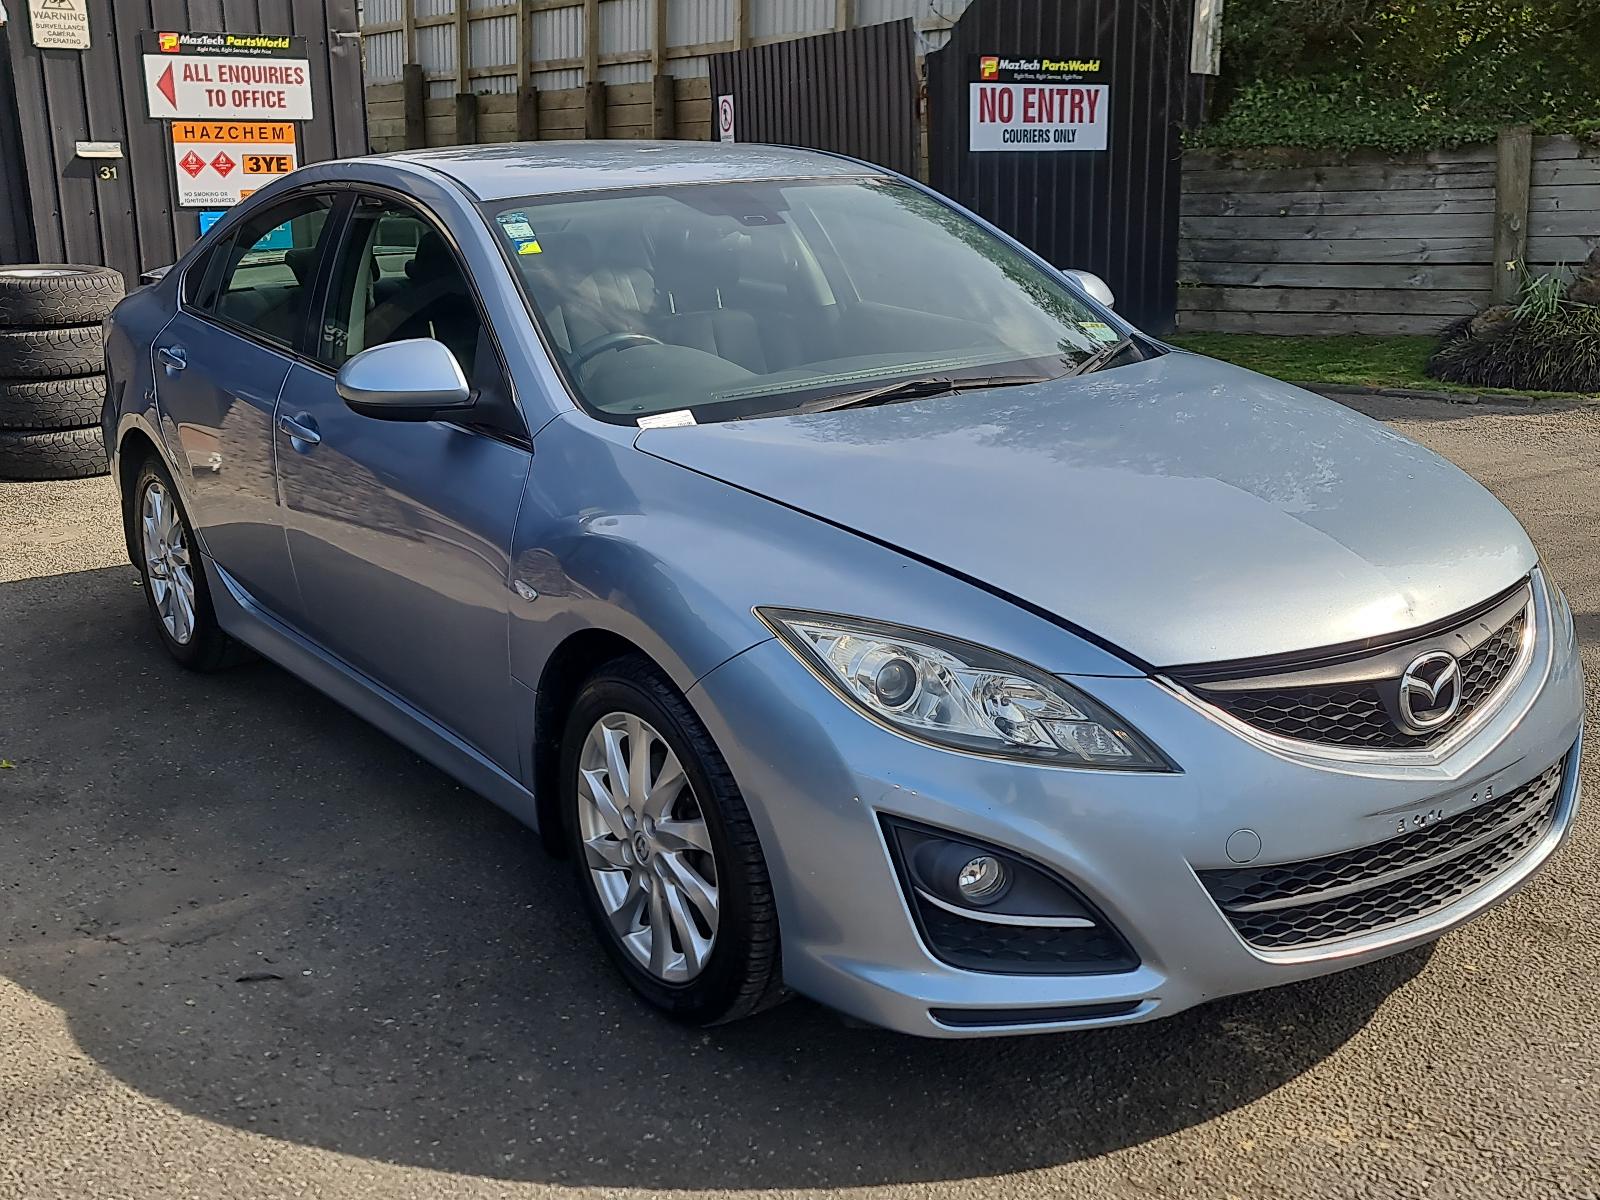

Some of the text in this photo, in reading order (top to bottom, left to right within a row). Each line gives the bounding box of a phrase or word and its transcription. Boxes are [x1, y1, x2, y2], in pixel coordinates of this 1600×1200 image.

[33, 11, 86, 22] WARNING
[35, 23, 86, 31] SURVEILLANCE
[43, 37, 81, 45] OPERATING
[179, 34, 290, 48] MazTech PartsWorld
[998, 59, 1100, 72] MazTech PartsWorld
[183, 63, 305, 85] ALL ENQUIRIES
[205, 89, 287, 109] TO OFFICE
[979, 87, 1100, 124] NO ENTRY
[183, 125, 285, 140] HAZCHEM
[1002, 128, 1077, 144] COURIERS ONLY
[248, 156, 289, 173] 3YE
[100, 166, 118, 180] 31
